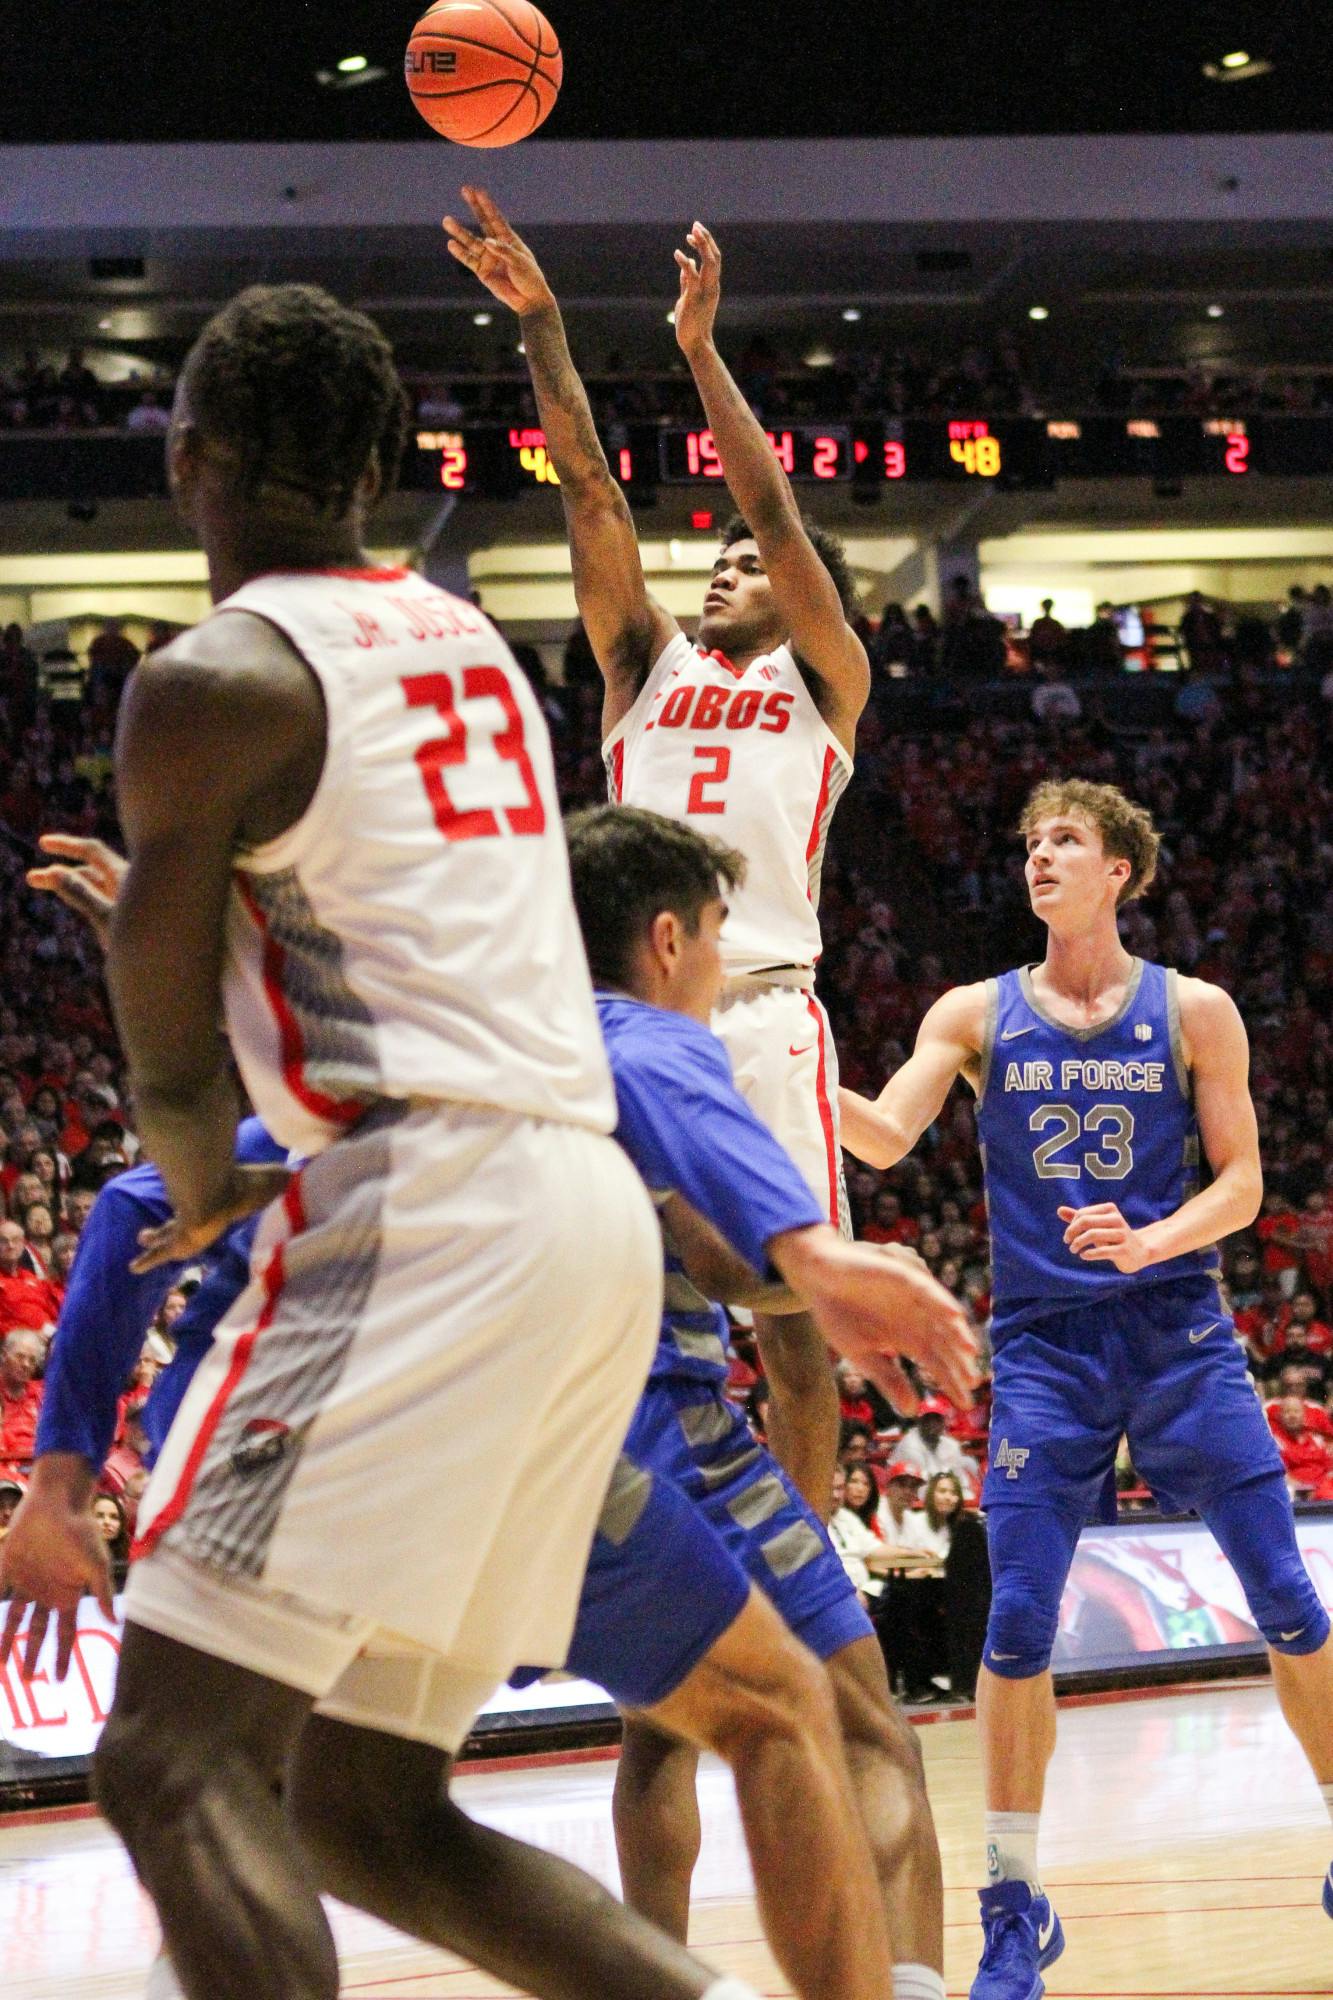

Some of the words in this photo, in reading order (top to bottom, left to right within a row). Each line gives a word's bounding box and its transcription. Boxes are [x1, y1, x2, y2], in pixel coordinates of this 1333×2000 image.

[441, 448, 467, 488] 2
[619, 449, 632, 480] 1
[813, 437, 838, 479] 2
[883, 440, 907, 479] 3
[949, 436, 1001, 478] 48
[1225, 433, 1250, 474] 2
[399, 664, 546, 843] 23
[686, 745, 731, 815] 2
[1004, 1060, 1054, 1093] AIR
[1061, 1059, 1166, 1093] FORCE
[1028, 1103, 1135, 1180] 23
